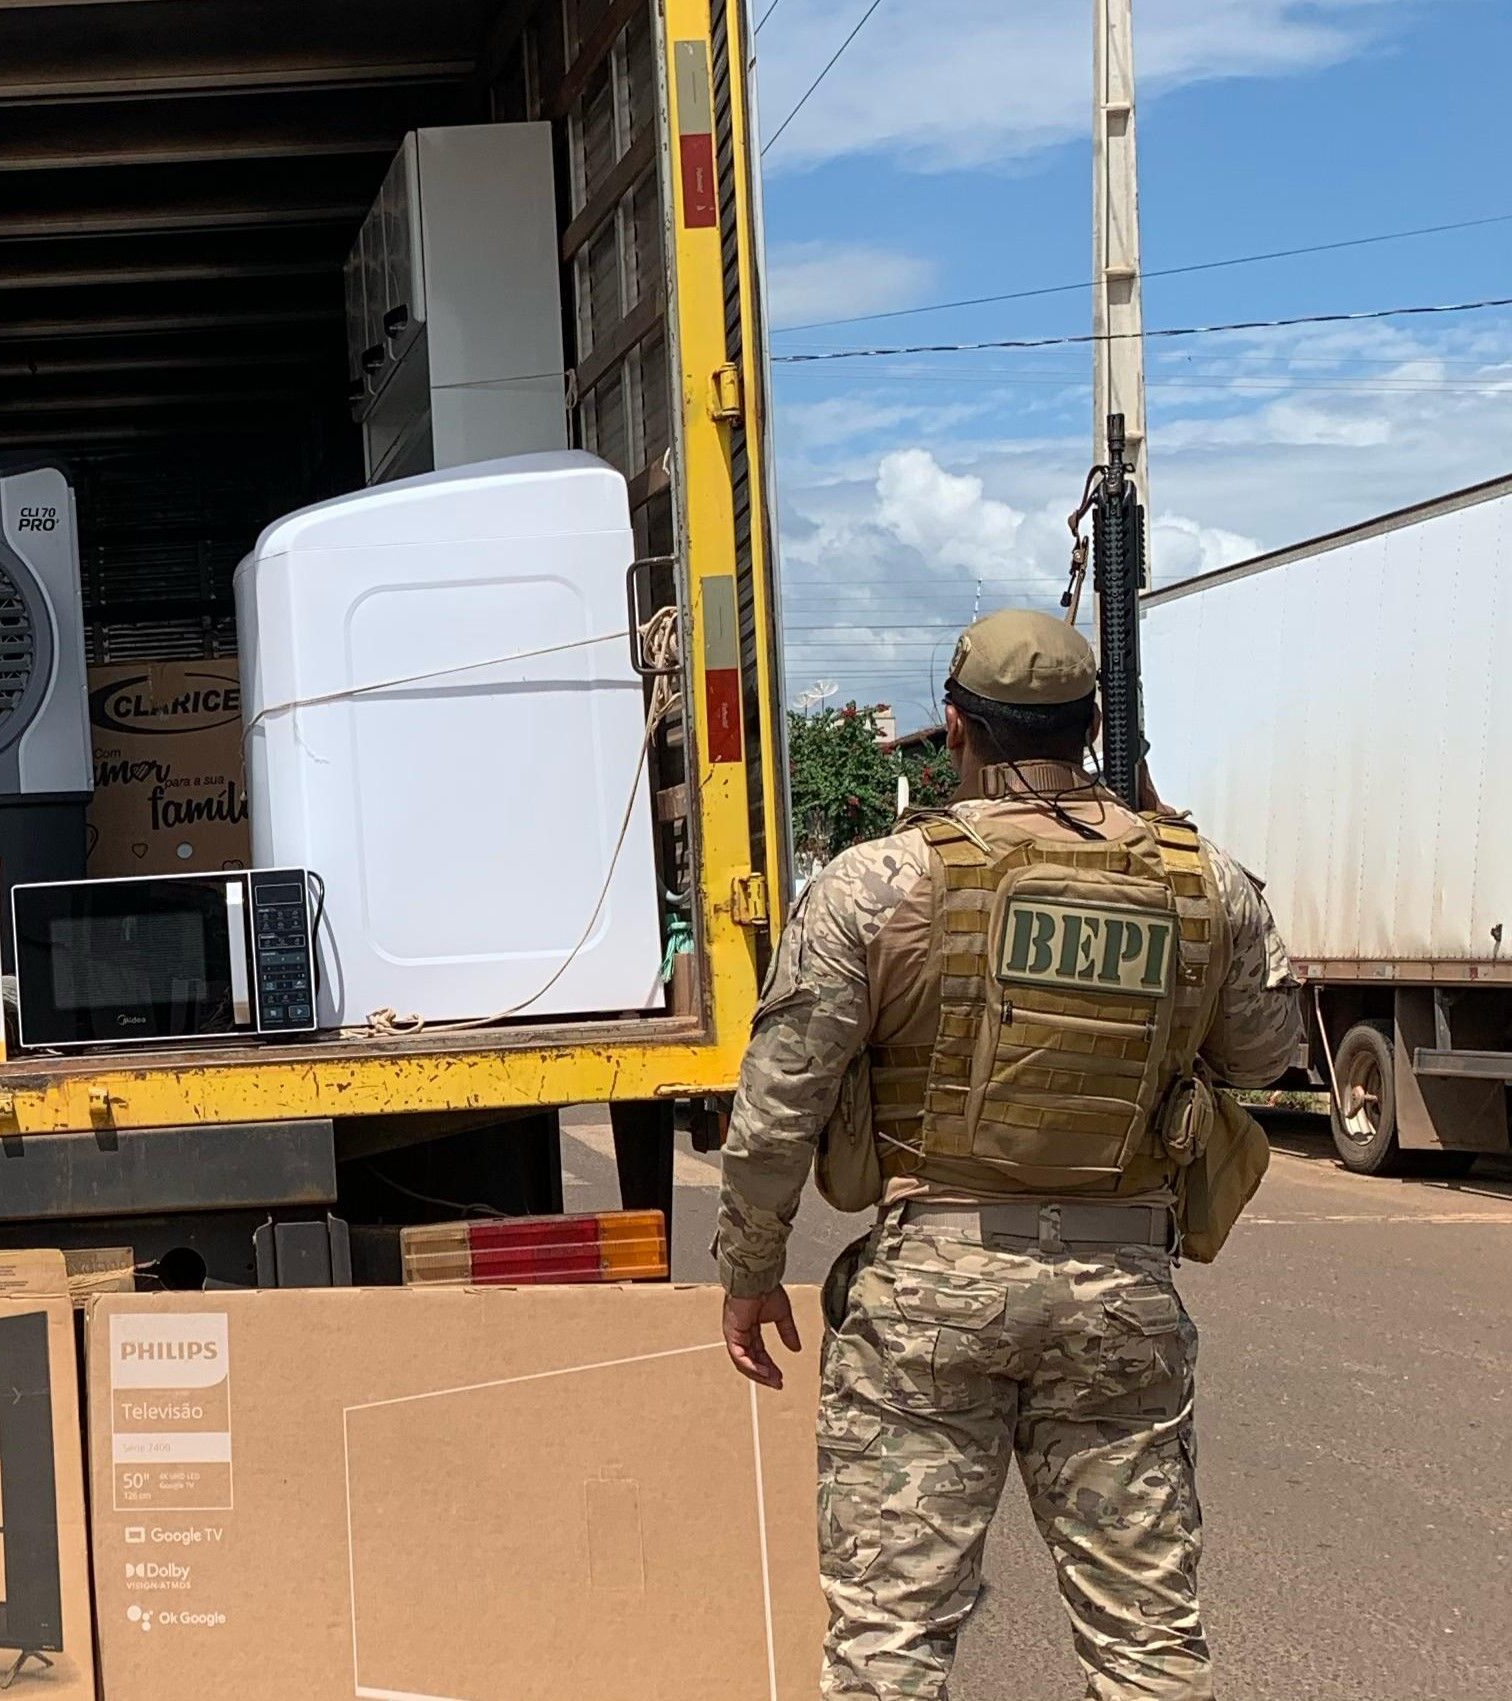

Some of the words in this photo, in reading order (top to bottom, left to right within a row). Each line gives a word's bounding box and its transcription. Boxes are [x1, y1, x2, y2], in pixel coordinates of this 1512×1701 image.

[20, 507, 39, 518] CLI
[41, 507, 56, 518] 70
[18, 518, 56, 532] PRO
[94, 748, 121, 760] Com
[164, 776, 190, 789] para
[193, 777, 201, 786] a
[203, 775, 225, 786] sua
[1006, 909, 1170, 989] BEPI
[120, 1341, 218, 1361] PHILIPS
[121, 1402, 204, 1421] Televisão
[123, 1472, 150, 1490] 50"
[150, 1526, 202, 1546] Google
[204, 1527, 224, 1542] TV
[146, 1562, 191, 1581] Dolby
[158, 1610, 179, 1625] Ok
[179, 1610, 227, 1628] Google
